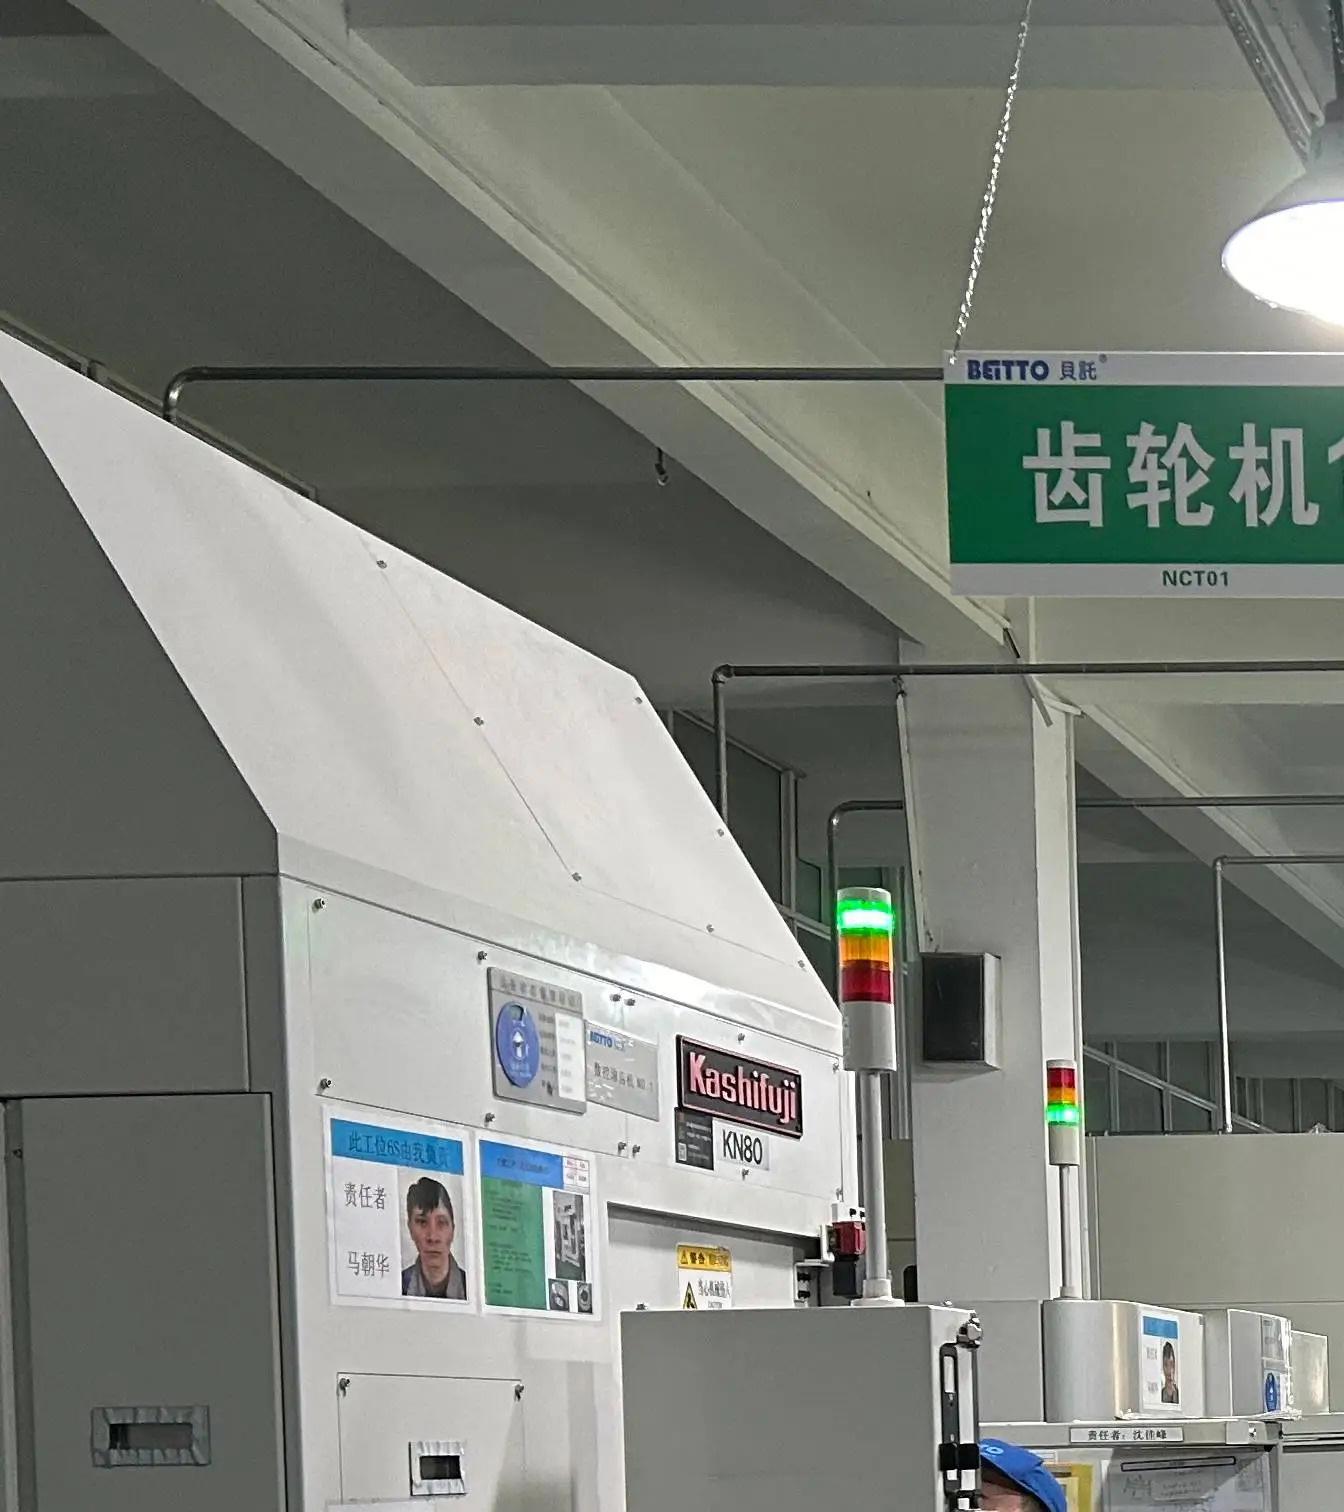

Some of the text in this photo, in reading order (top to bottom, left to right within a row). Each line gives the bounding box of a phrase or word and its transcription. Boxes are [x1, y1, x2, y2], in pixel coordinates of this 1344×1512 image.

[967, 360, 1049, 381] BEITTO
[1162, 570, 1229, 588] NCT01
[689, 1051, 796, 1124] Kashifuji
[722, 1129, 763, 1165] KN80
[344, 1182, 387, 1210] 责任者
[347, 1251, 390, 1278] 马朝华
